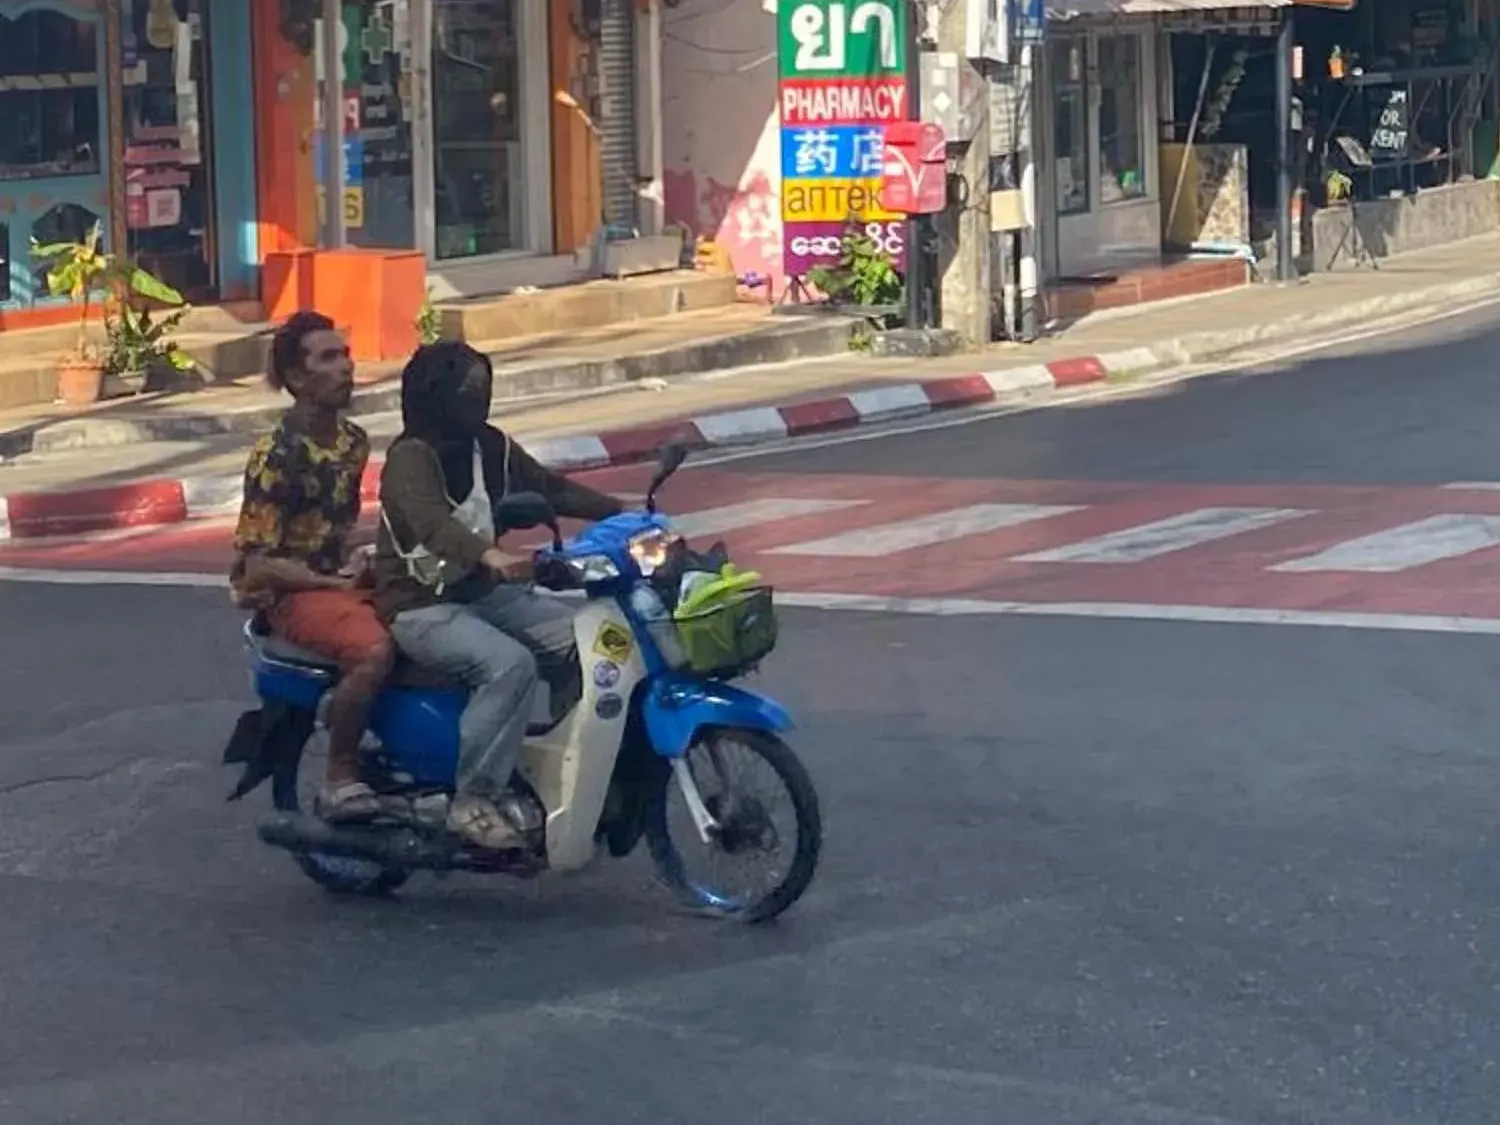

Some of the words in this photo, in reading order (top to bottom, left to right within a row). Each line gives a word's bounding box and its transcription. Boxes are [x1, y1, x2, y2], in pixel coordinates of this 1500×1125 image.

[791, 0, 897, 71] ยา
[783, 84, 905, 121] PHARMACY
[787, 184, 886, 214] аптек
